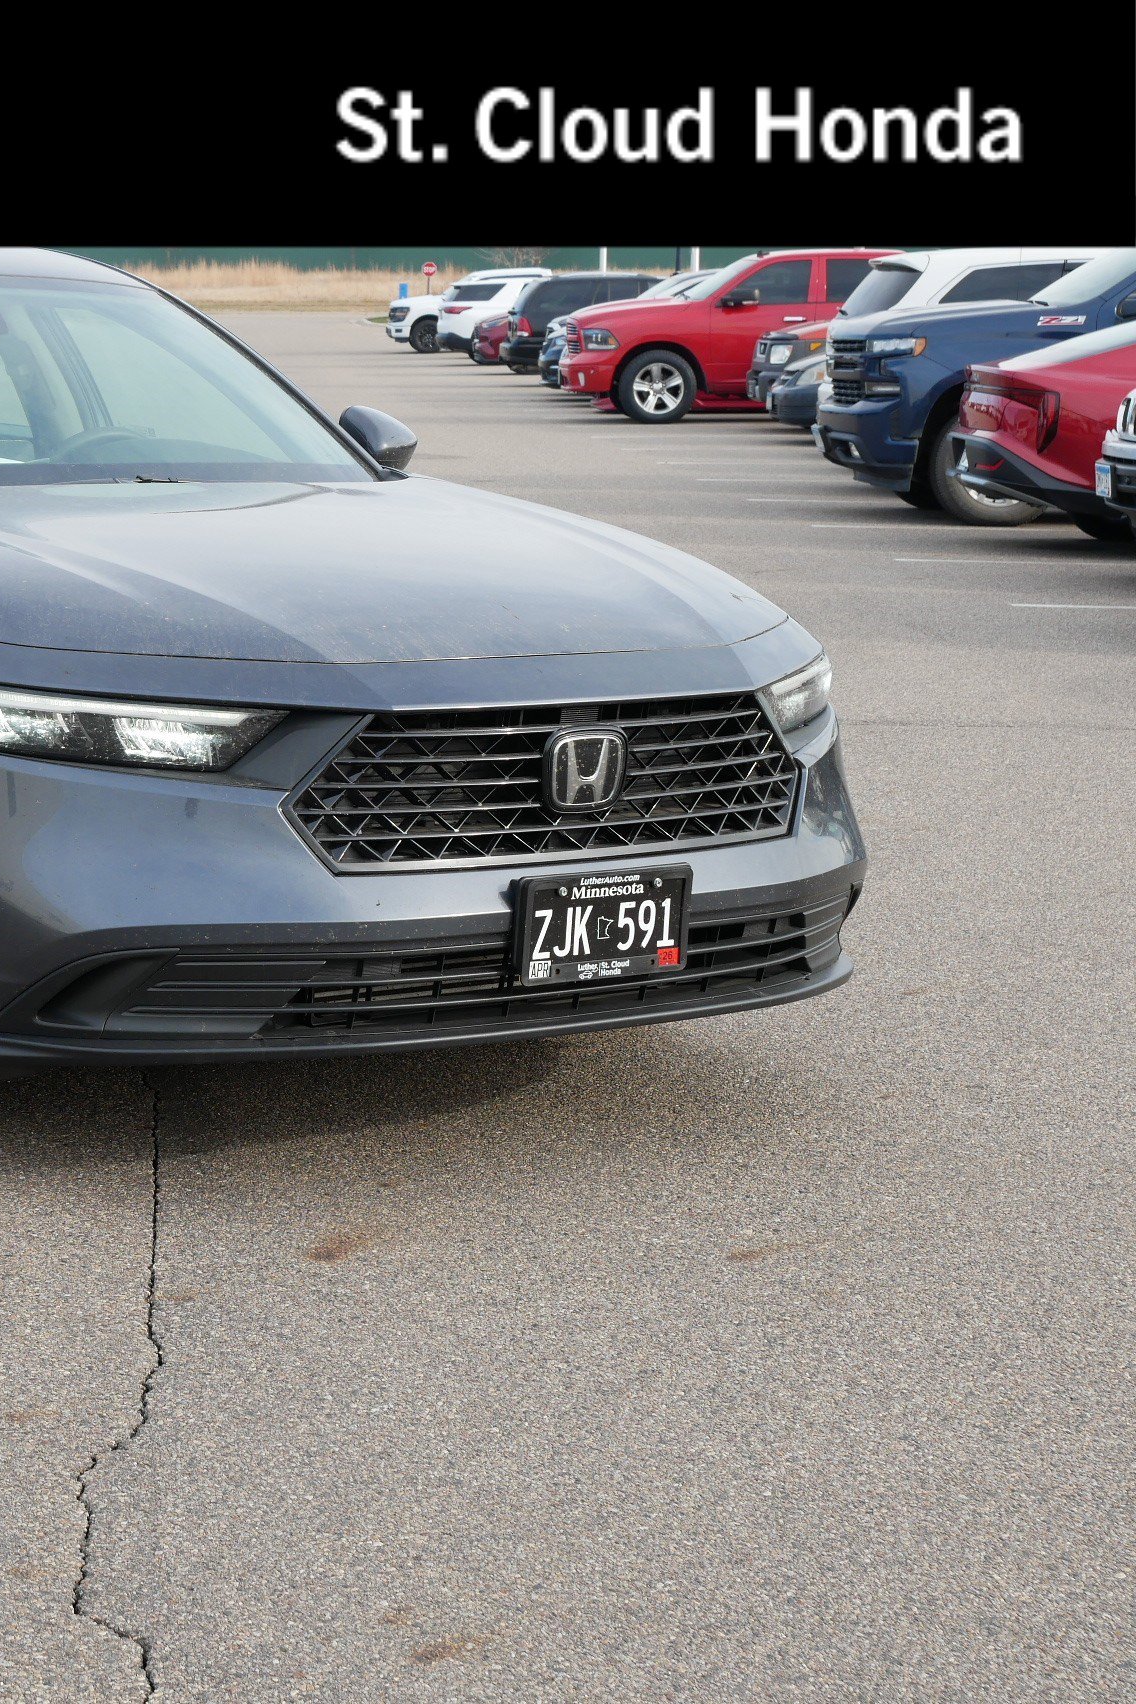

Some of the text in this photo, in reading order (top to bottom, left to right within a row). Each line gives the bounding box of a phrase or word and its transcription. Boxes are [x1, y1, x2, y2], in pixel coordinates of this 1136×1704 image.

[1037, 315, 1086, 326] Z71
[580, 874, 640, 886] LutherAuto.com
[570, 883, 644, 900] Minnesota
[532, 898, 675, 960] ZJK 591
[662, 951, 673, 960] 26
[578, 962, 599, 972] Luther
[611, 959, 630, 969] Cloud
[600, 968, 622, 977] Honda
